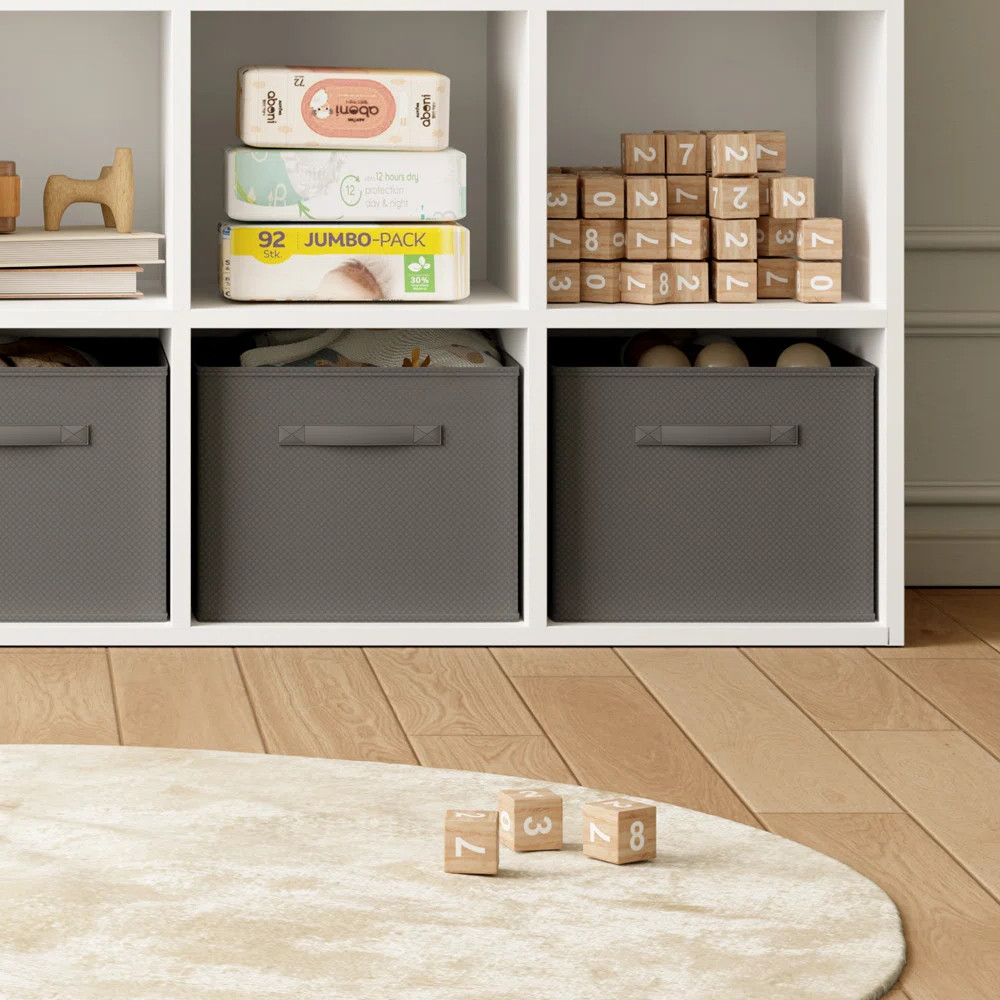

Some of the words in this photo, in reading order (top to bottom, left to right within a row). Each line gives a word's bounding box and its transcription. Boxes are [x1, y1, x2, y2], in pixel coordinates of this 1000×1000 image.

[293, 78, 305, 87] 72
[335, 105, 379, 117] aboni
[679, 143, 694, 166] 7
[384, 171, 405, 182] hours
[406, 172, 419, 184] dry
[345, 184, 356, 196] 12
[258, 230, 286, 248] 92
[304, 231, 426, 247] JUMBO-PACK
[584, 228, 599, 252] 8
[263, 249, 283, 259] Stk.
[410, 276, 430, 284] 30%
[659, 271, 669, 296] 8
[630, 820, 645, 852] 8
